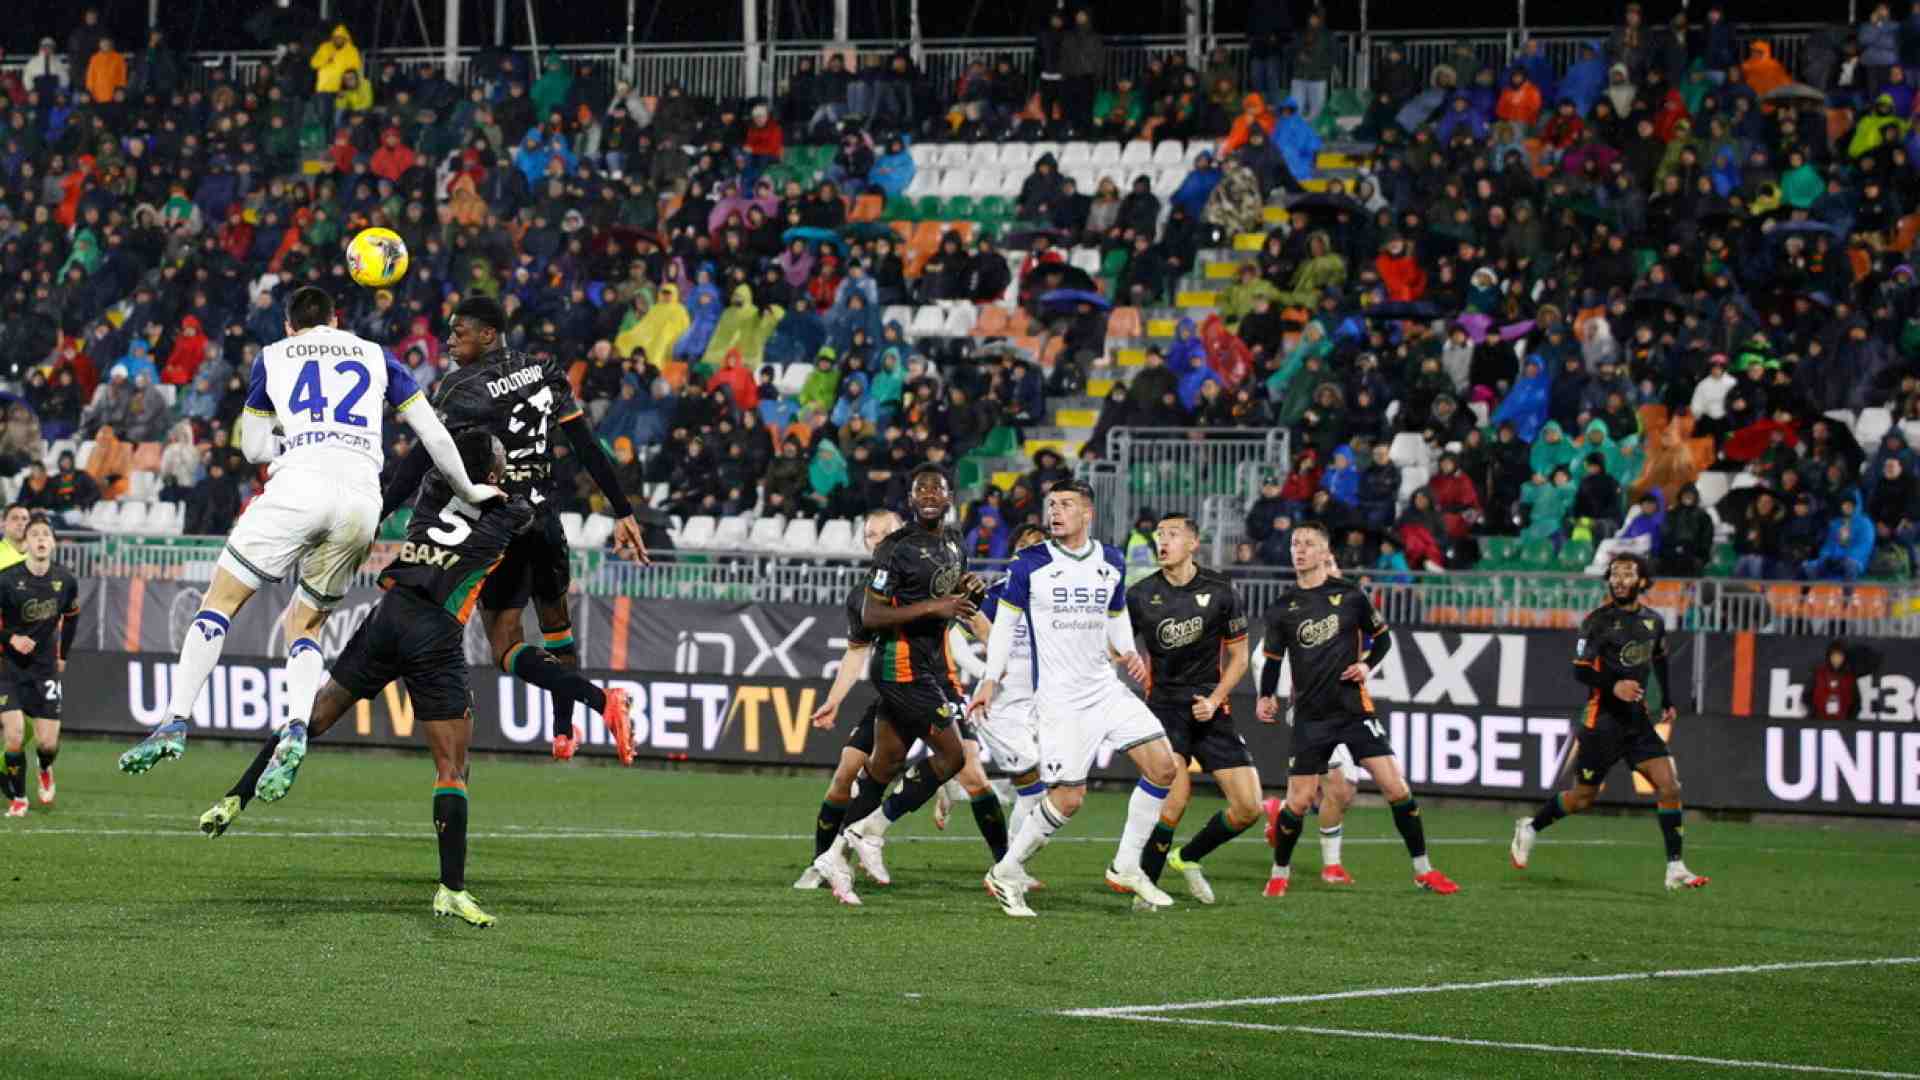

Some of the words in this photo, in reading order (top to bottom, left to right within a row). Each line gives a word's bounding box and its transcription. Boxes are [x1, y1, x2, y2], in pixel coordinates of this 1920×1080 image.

[285, 343, 365, 359] COPPOLA
[288, 360, 371, 428] 42
[426, 495, 482, 547] 5
[399, 541, 461, 571] BAXI
